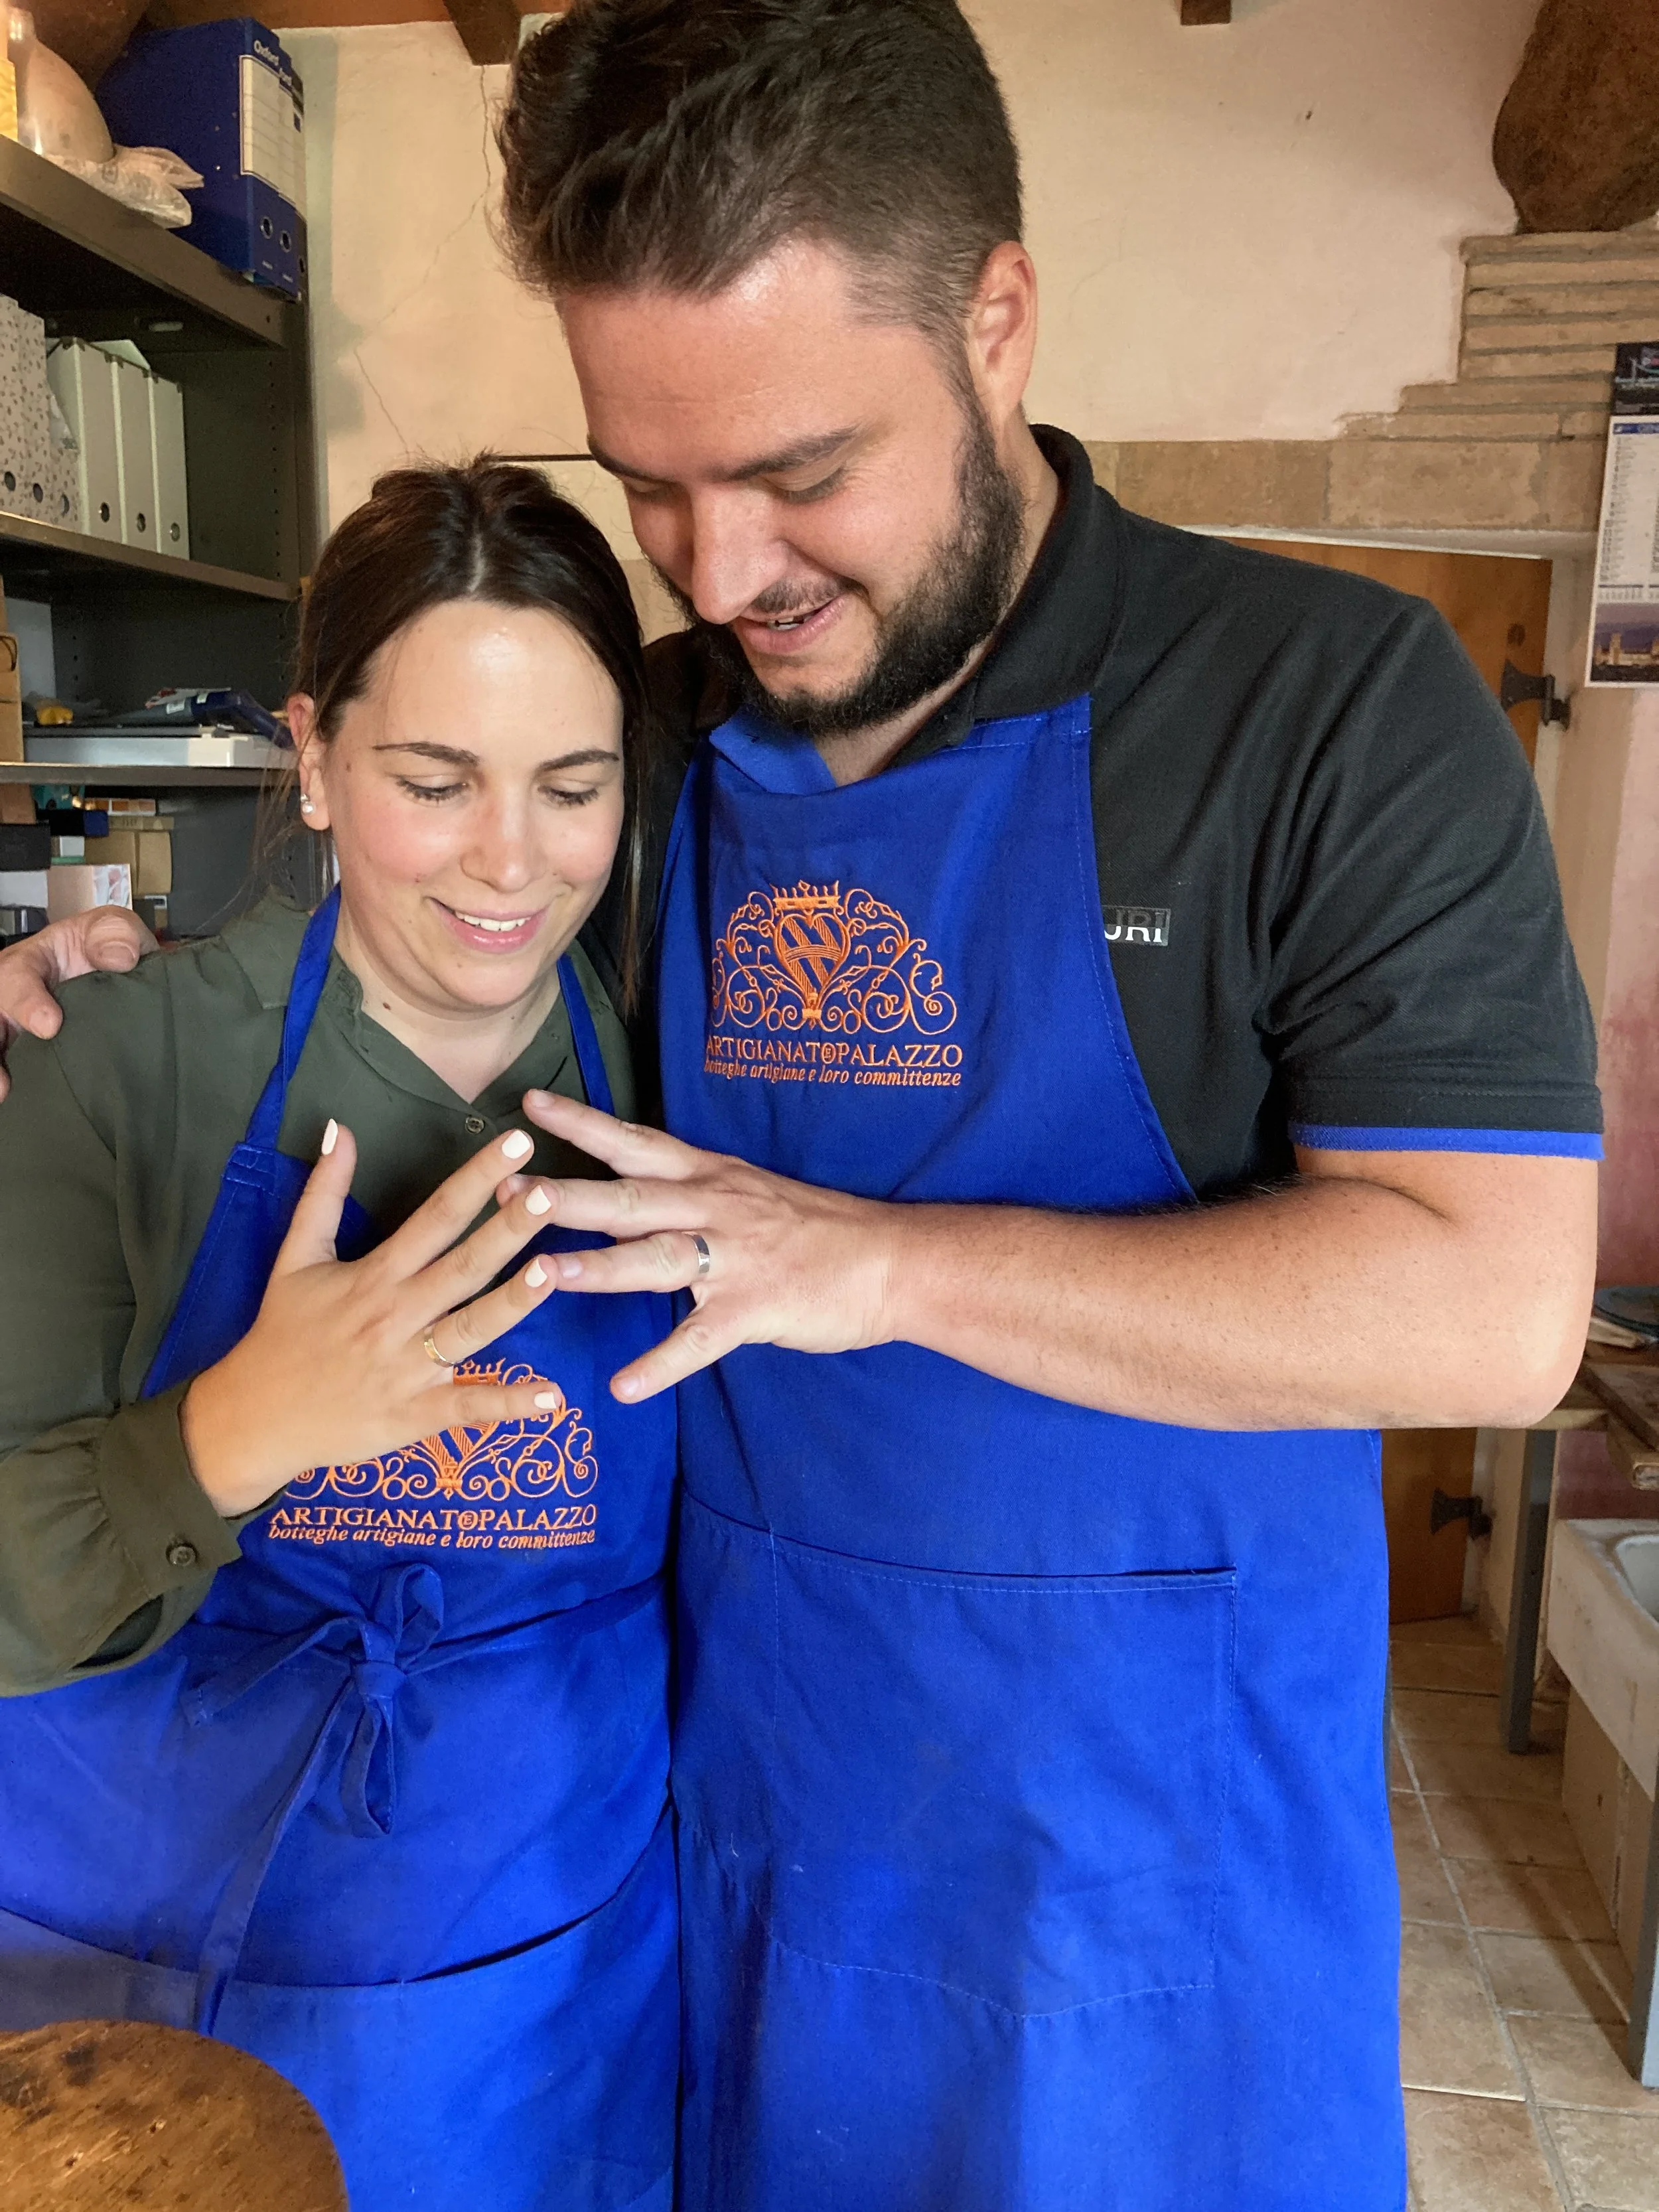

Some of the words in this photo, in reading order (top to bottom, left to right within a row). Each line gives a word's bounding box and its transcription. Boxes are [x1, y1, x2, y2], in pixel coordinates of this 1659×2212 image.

[253, 40, 279, 66] Oxford
[279, 68, 292, 86] ford
[704, 1056, 747, 1080] botteghe
[750, 1063, 806, 1084] artigiane
[808, 1069, 817, 1082] e
[818, 1065, 849, 1084] loro
[854, 1068, 962, 1086] committenze
[268, 1525, 348, 1544] botteghe
[352, 1528, 437, 1547] artigiane
[441, 1534, 452, 1547] e
[456, 1531, 493, 1548] loro
[498, 1530, 595, 1550] committenze
